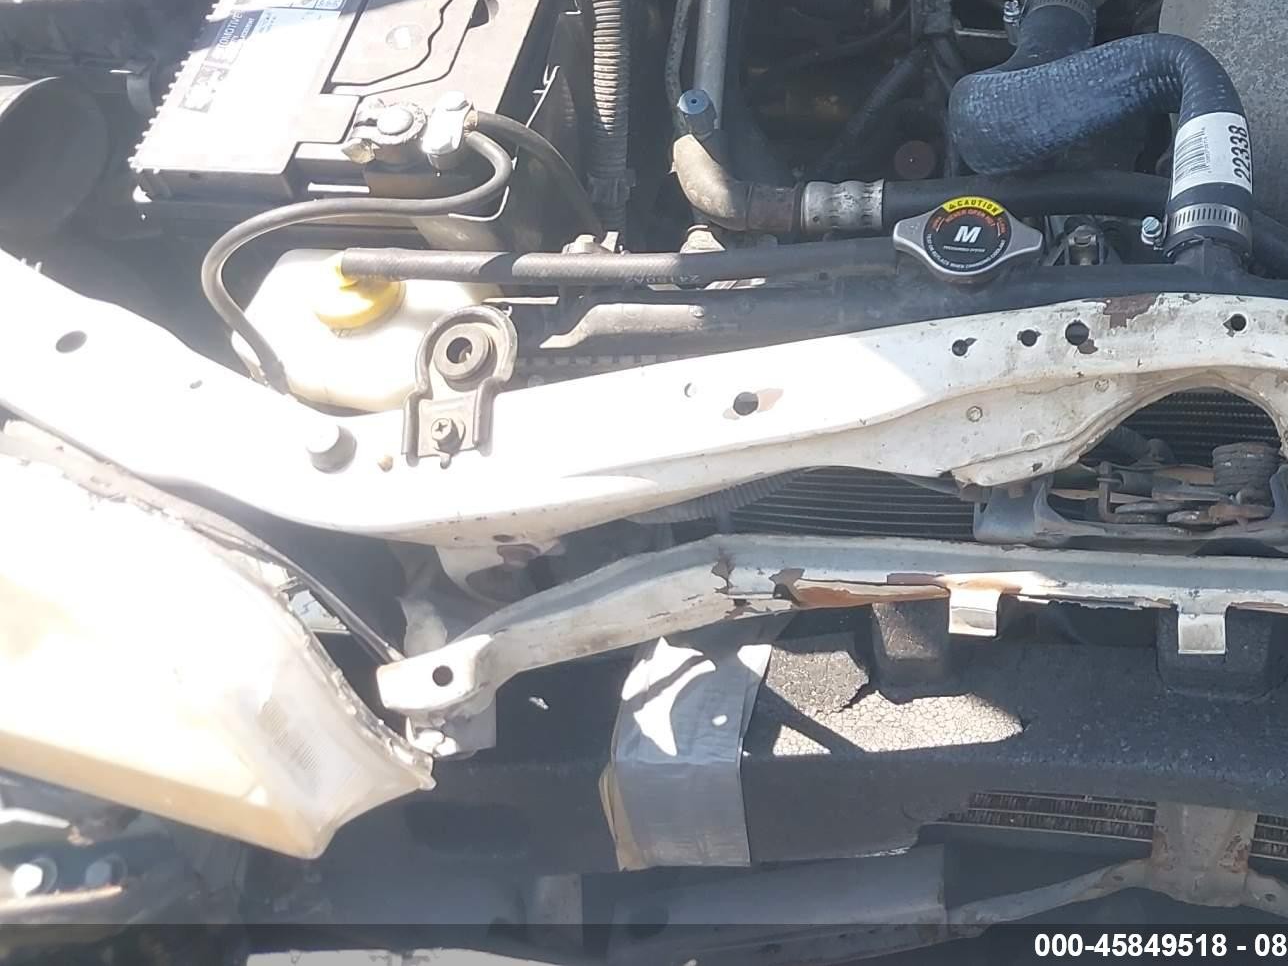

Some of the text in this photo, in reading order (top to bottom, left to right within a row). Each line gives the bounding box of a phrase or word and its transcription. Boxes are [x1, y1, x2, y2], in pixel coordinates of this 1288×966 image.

[1228, 125, 1251, 184] 22338
[957, 199, 999, 214] CAUTION
[954, 225, 982, 244] M
